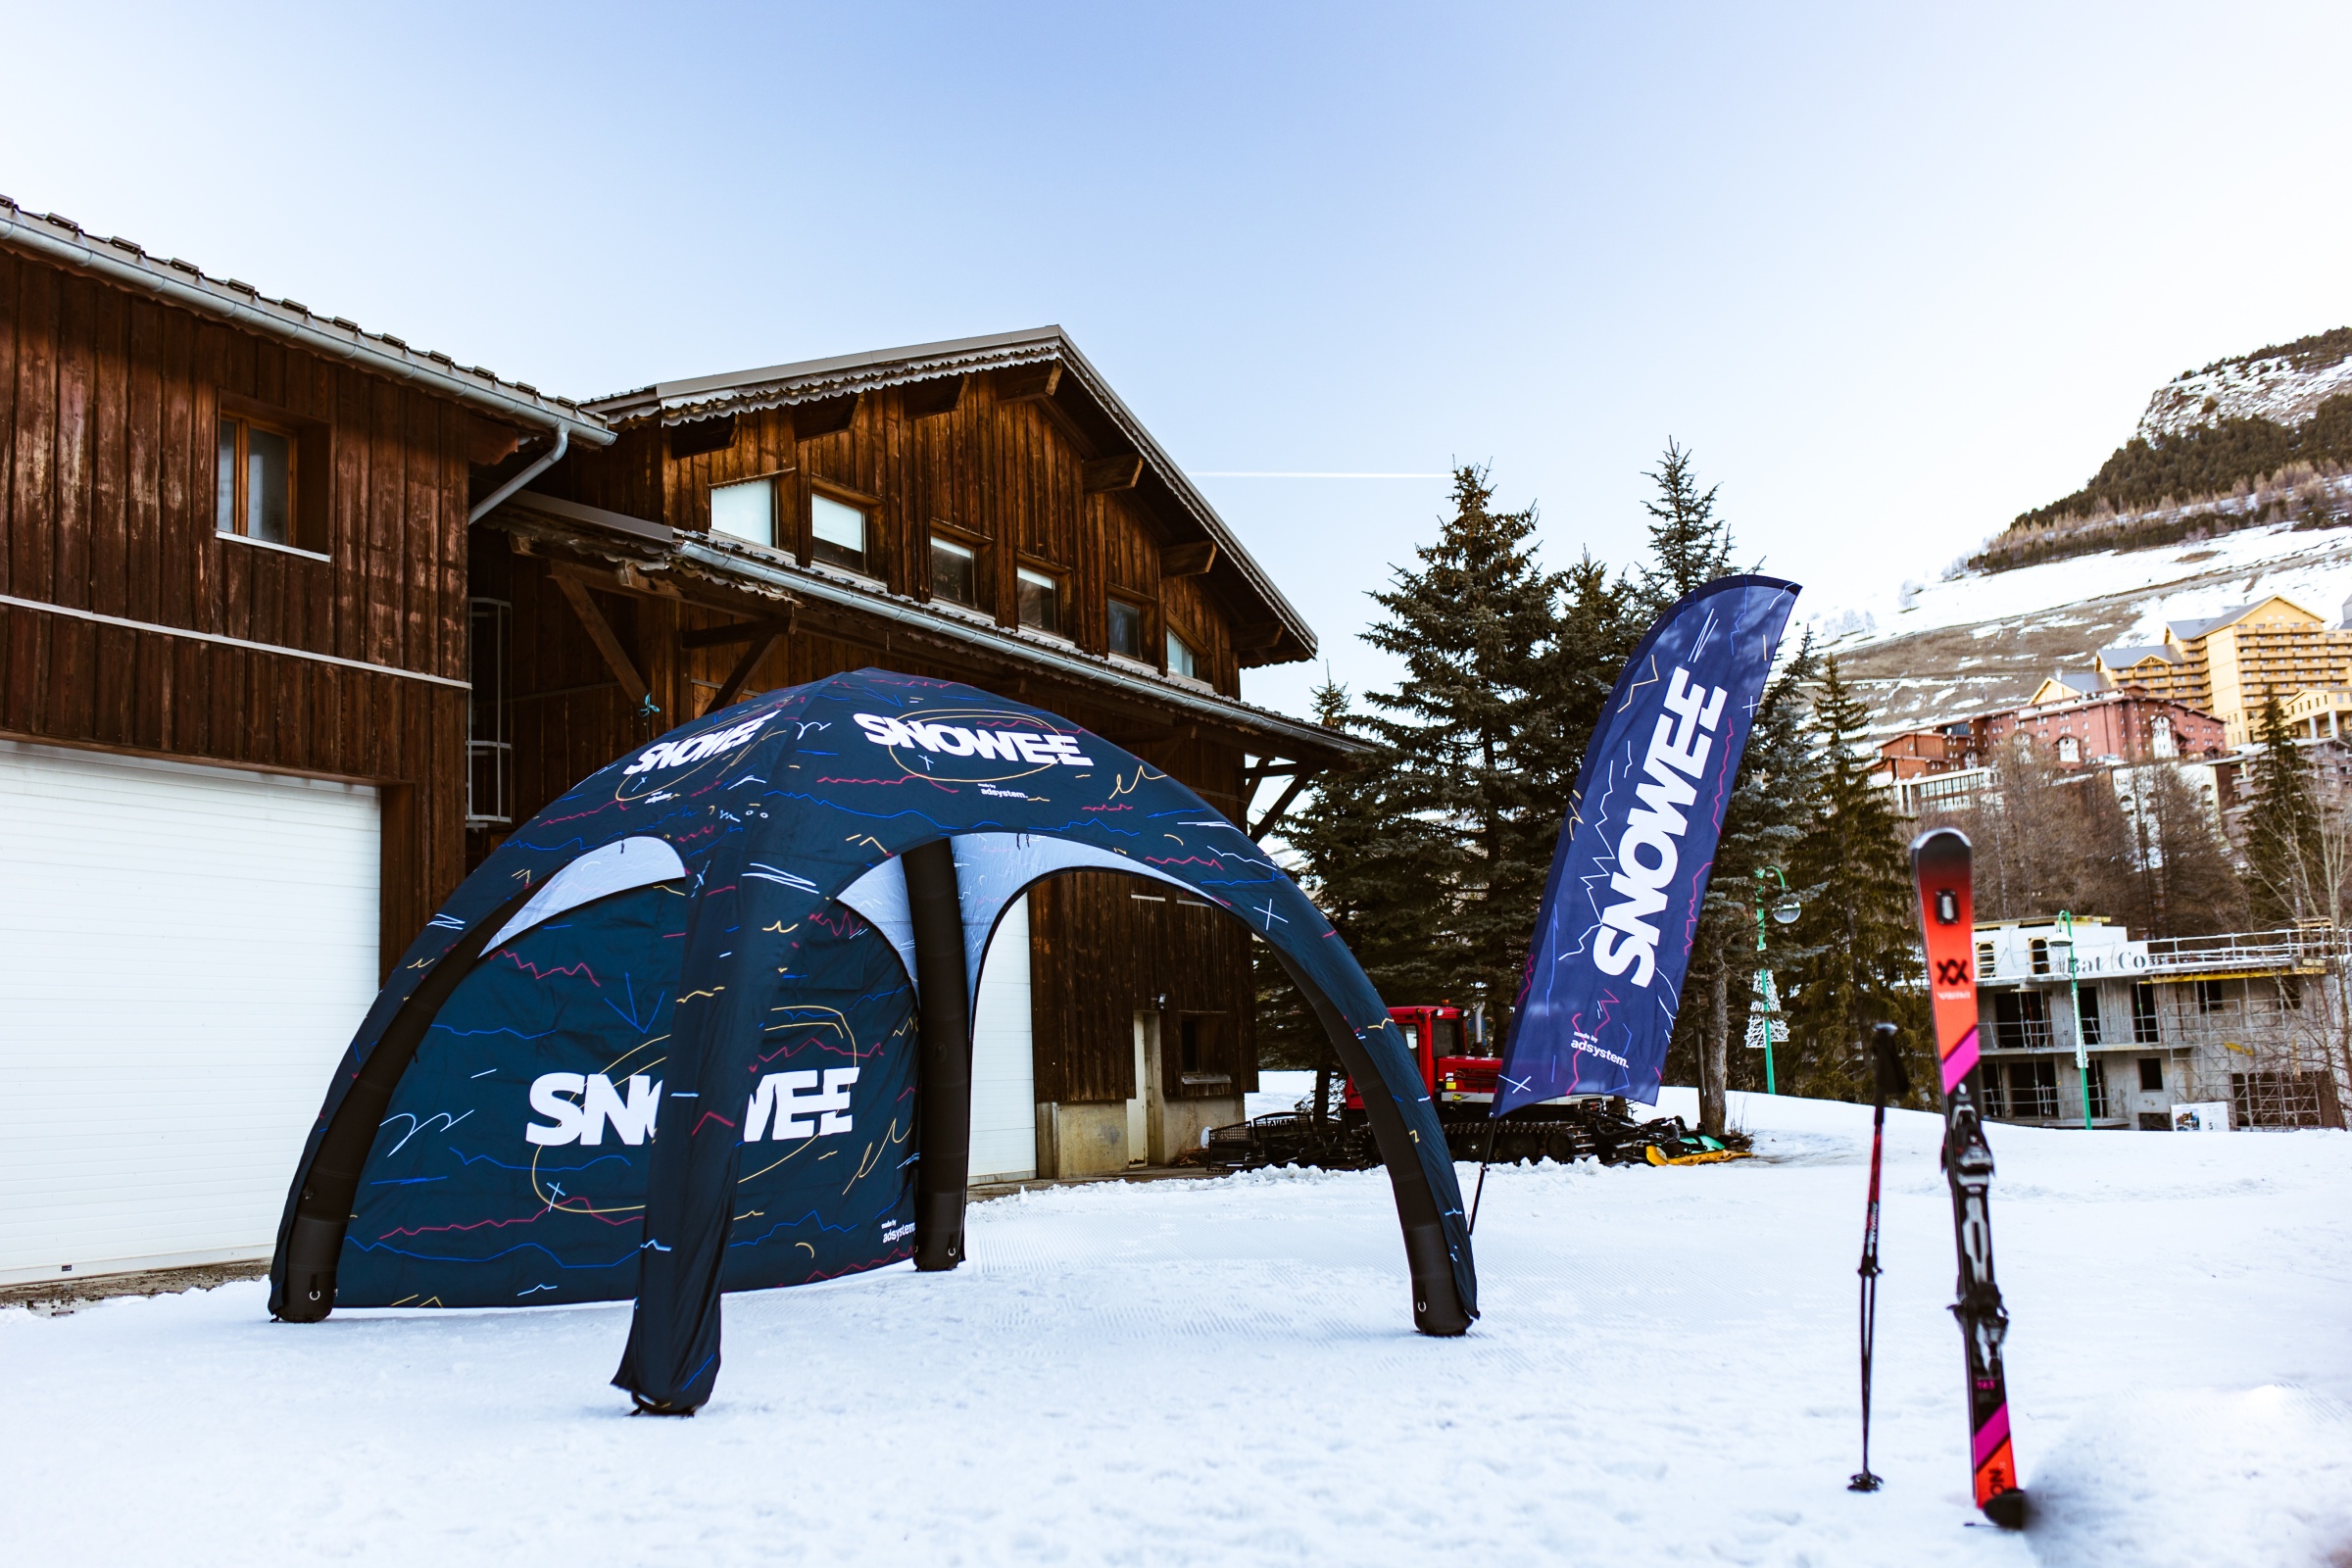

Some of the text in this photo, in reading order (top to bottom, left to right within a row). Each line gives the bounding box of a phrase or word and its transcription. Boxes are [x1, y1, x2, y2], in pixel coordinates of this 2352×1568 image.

[622, 710, 781, 775] SNOWEE
[853, 713, 1095, 766] SNOWEE
[981, 788, 1029, 798] adsystem.
[1592, 666, 1728, 988] SNOWEE
[1570, 1039, 1630, 1069] adsystem.
